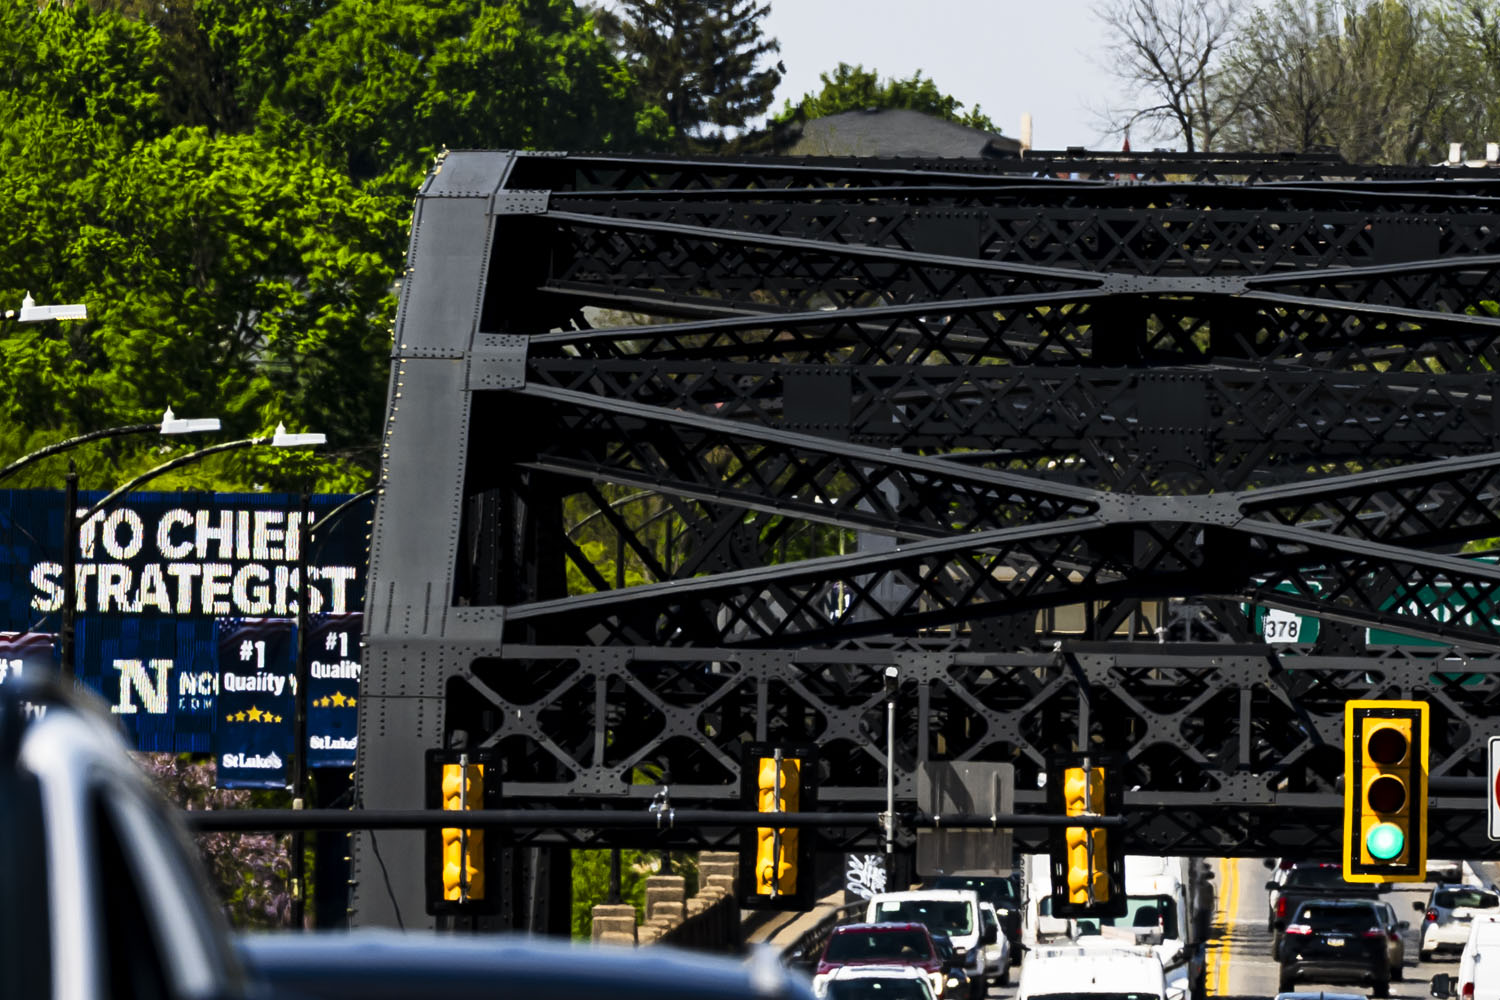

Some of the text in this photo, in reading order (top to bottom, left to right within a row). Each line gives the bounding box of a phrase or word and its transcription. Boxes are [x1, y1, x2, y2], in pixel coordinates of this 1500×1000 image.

[75, 508, 315, 561] TO CHIEF
[30, 562, 357, 614] STRATEGIST
[1267, 621, 1298, 638] 378
[239, 640, 266, 668] #1
[325, 632, 348, 657] #1
[223, 672, 286, 696] Quality
